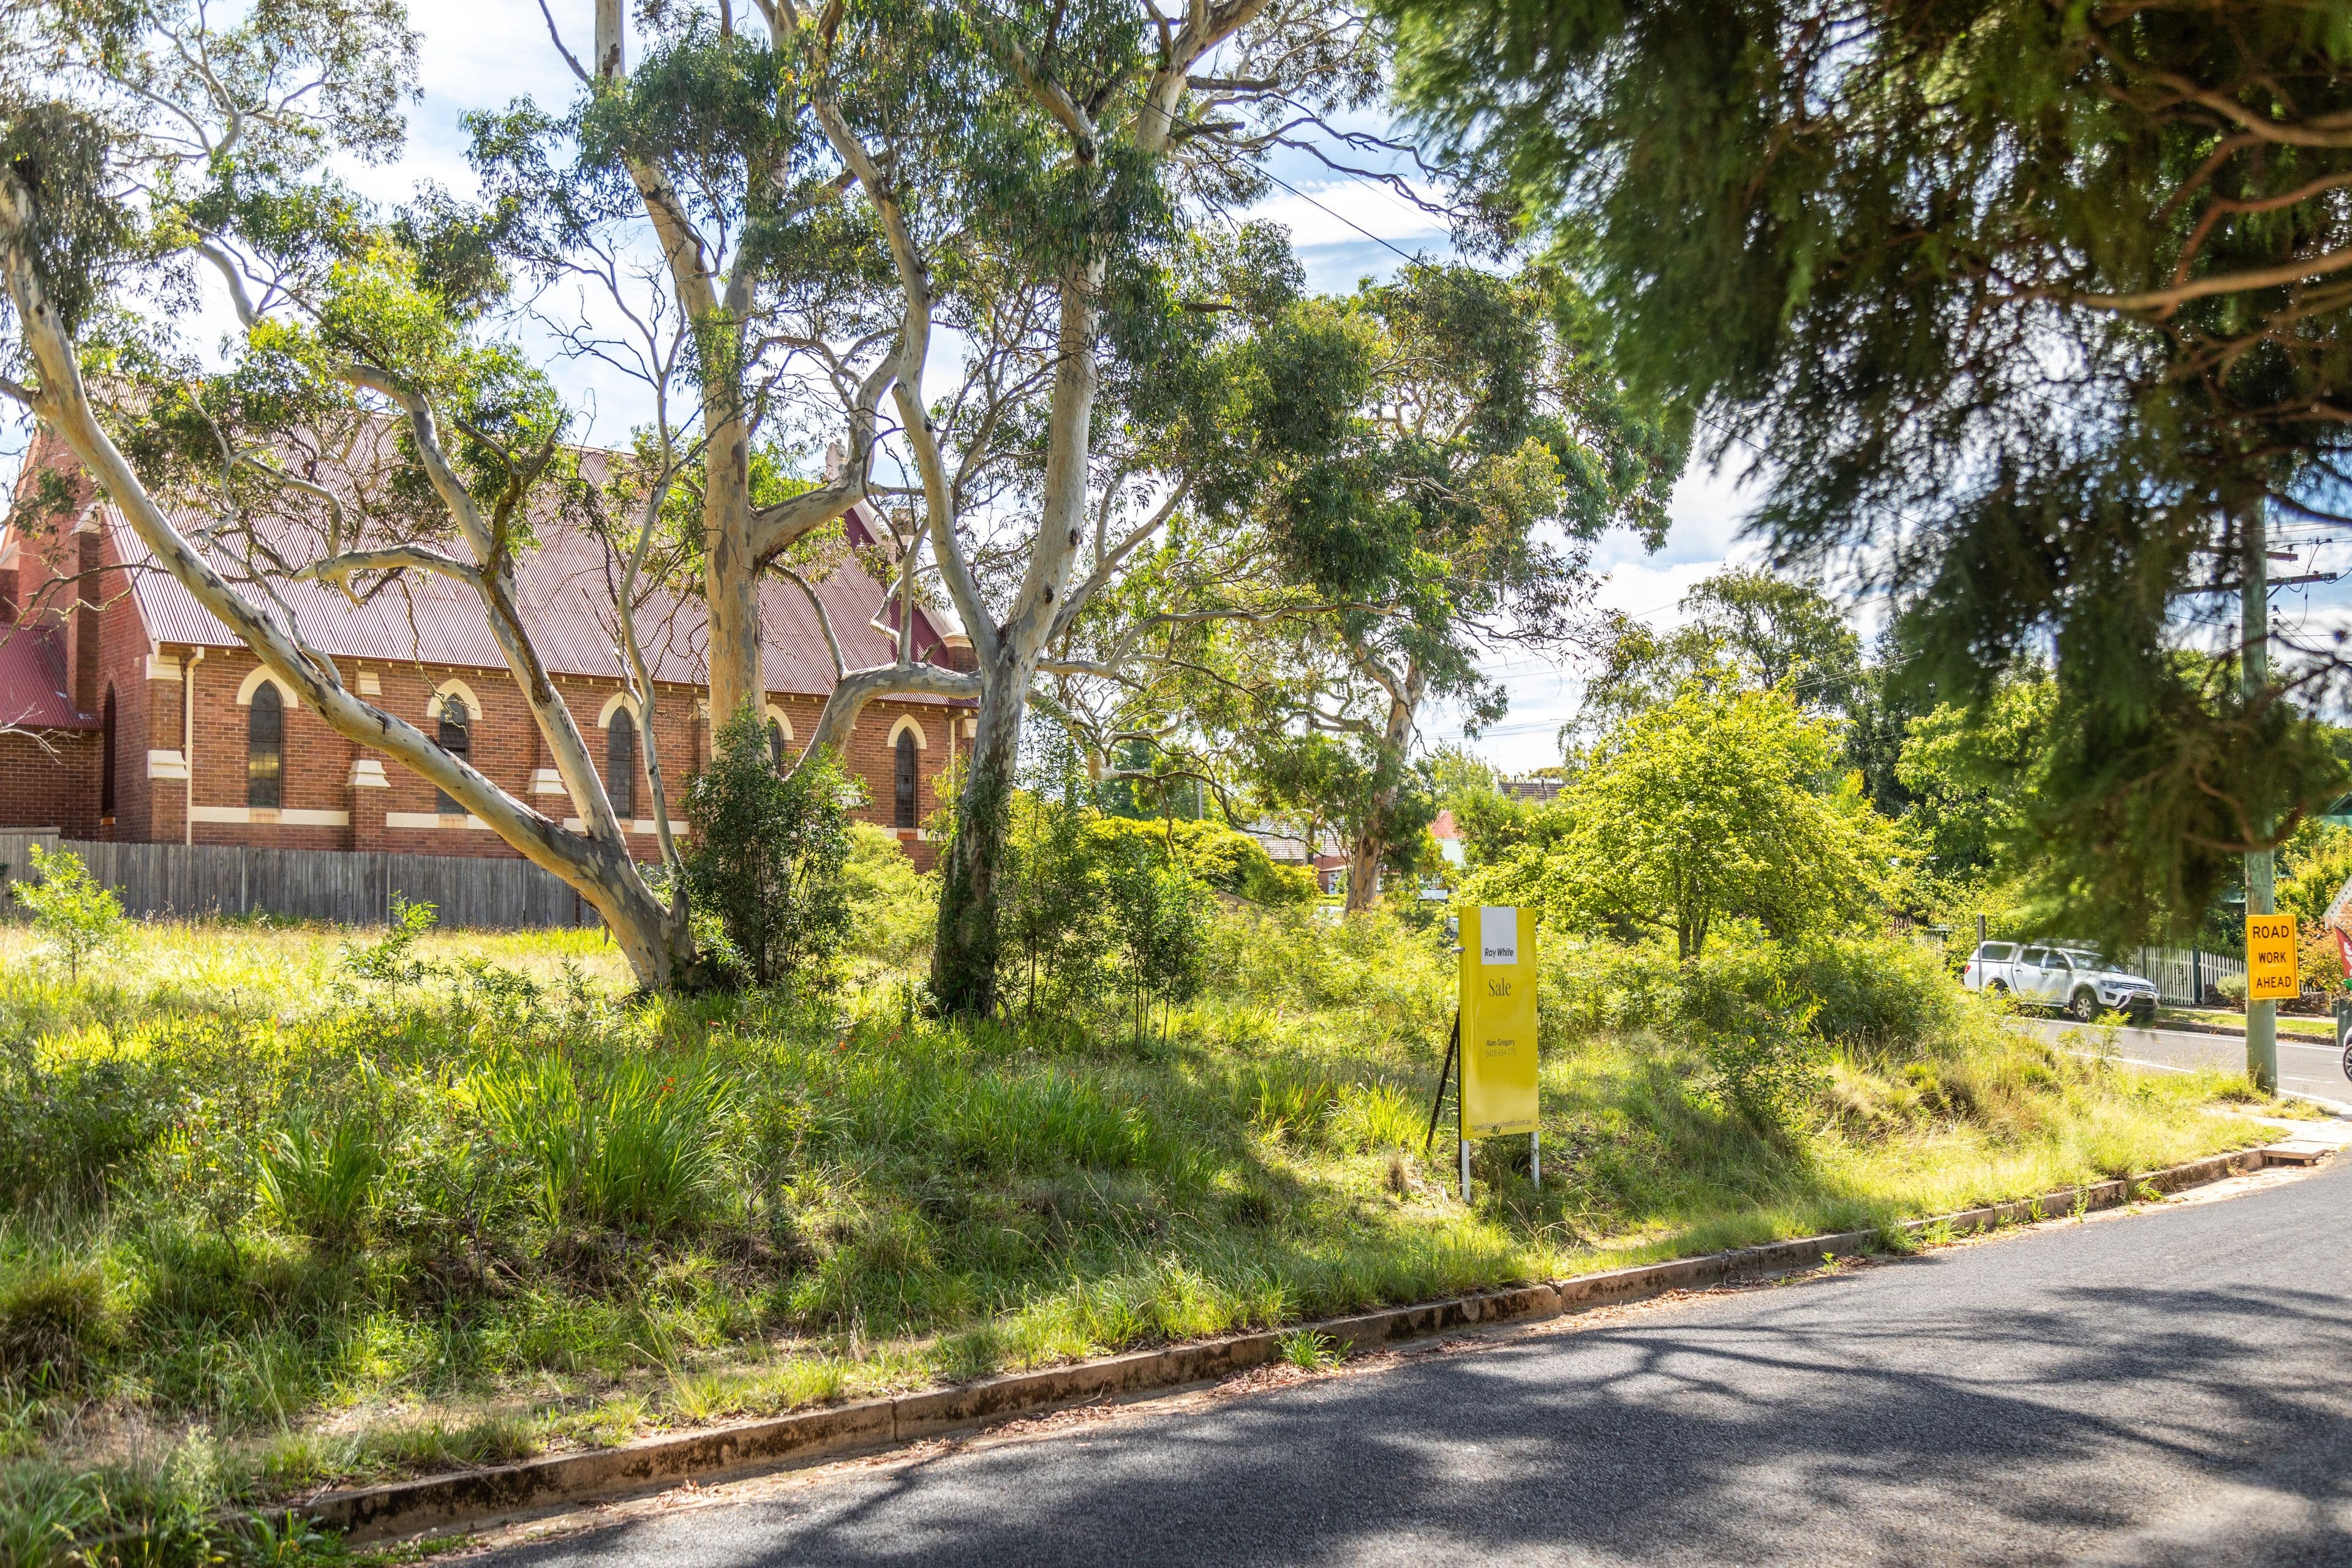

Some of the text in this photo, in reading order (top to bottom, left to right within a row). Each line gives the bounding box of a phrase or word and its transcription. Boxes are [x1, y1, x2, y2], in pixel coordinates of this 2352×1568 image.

[2253, 925, 2289, 939] ROAD
[1484, 948, 1514, 959] Ray White
[2258, 951, 2286, 964] WORK
[1488, 978, 1512, 997] Sale
[2256, 976, 2291, 989] AHEAD
[1497, 1039, 1515, 1047] Gregory
